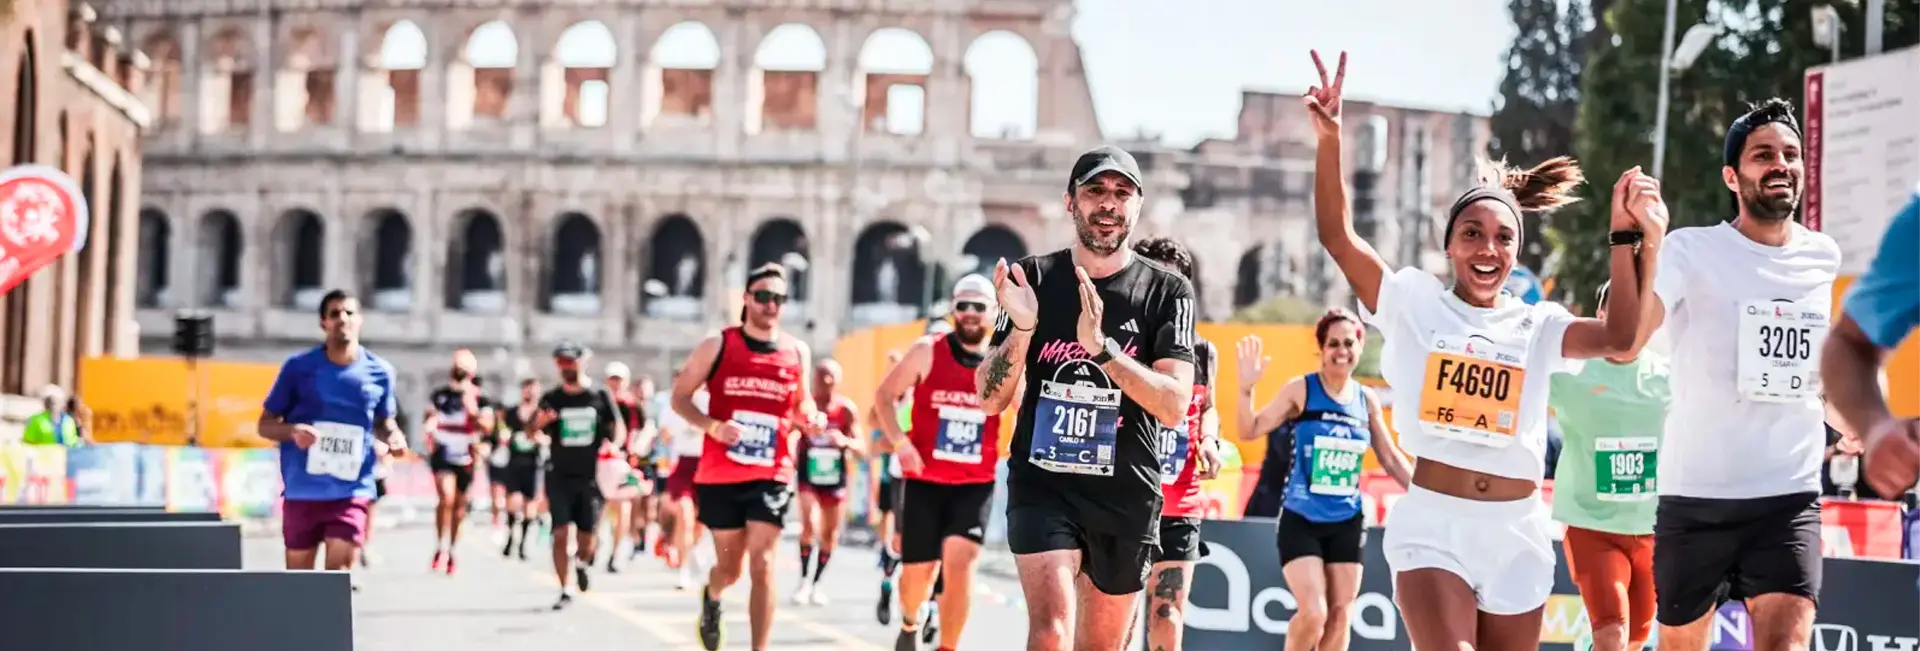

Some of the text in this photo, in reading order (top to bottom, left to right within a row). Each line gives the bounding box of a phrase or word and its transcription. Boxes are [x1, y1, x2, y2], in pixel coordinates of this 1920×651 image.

[1758, 325, 1810, 360] 3205
[1436, 359, 1511, 401] F4690
[1761, 373, 1802, 390] 5 D
[1052, 405, 1098, 437] 2161
[1437, 406, 1489, 429] F6 A
[1160, 430, 1178, 454] 16
[1048, 445, 1092, 463] 3 C
[1609, 452, 1645, 475] 1903
